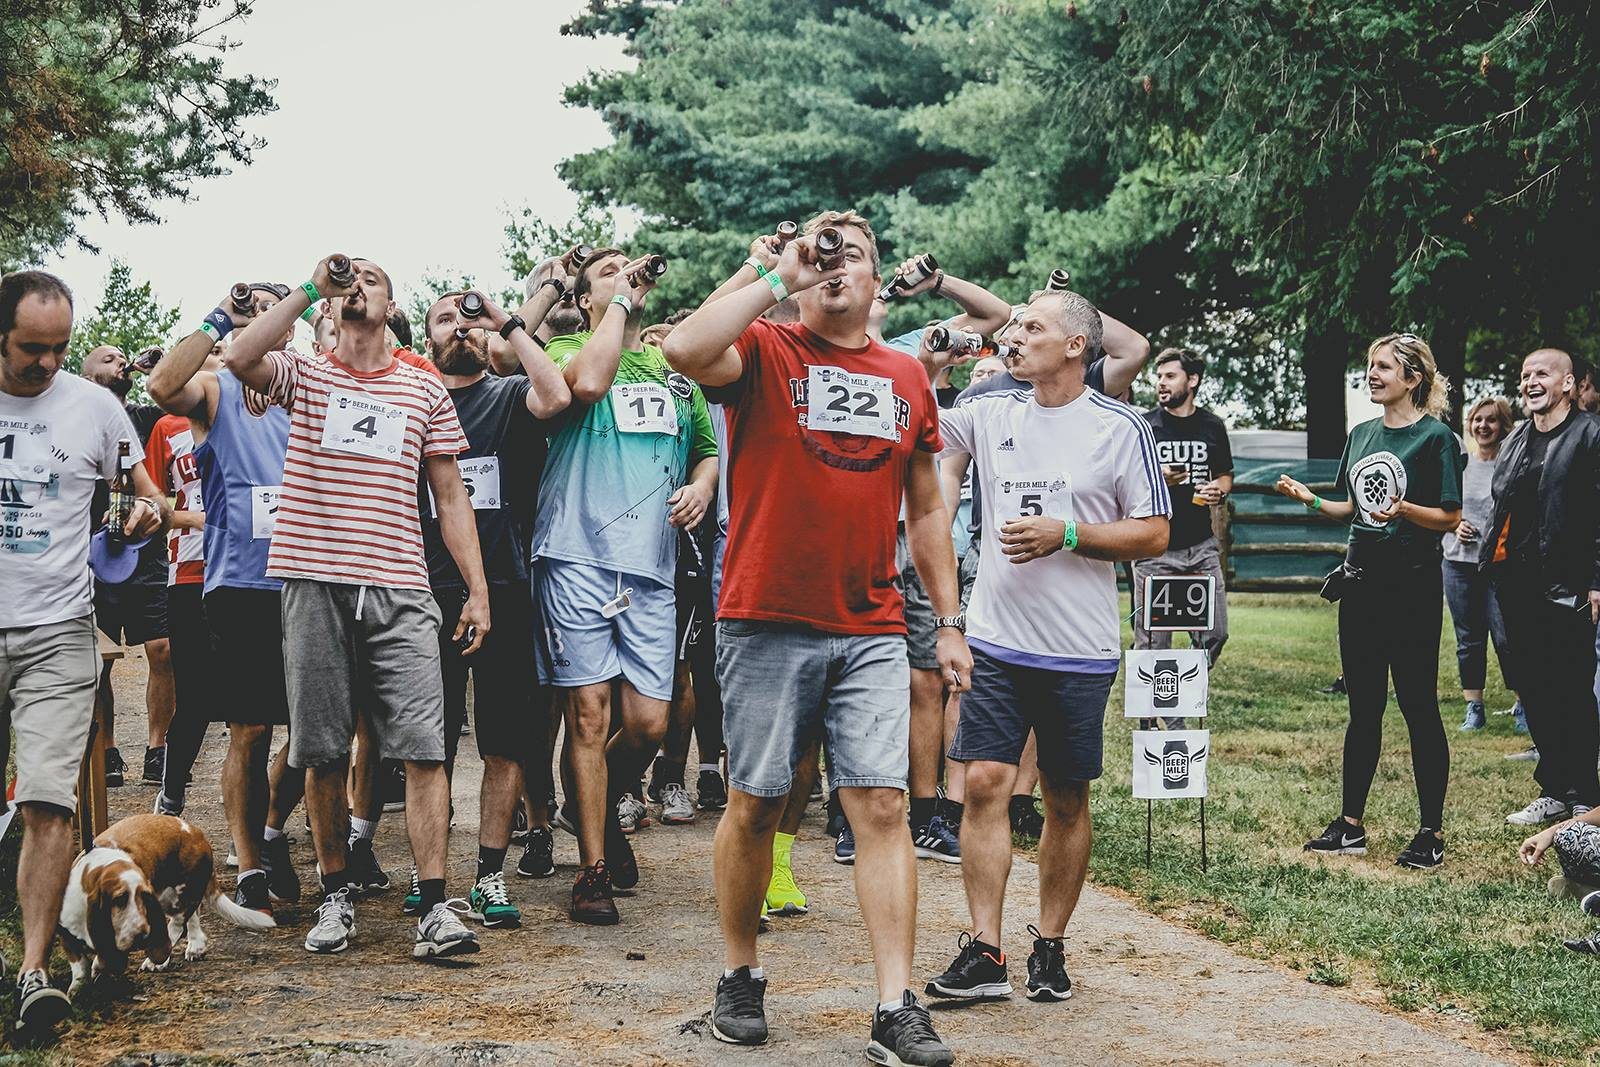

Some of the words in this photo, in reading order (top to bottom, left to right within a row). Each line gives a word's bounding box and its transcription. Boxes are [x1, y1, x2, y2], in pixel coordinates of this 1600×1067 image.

[851, 378, 869, 387] MILE
[826, 385, 880, 417] 22
[352, 400, 369, 410] BEER
[369, 404, 387, 414] MILE
[629, 397, 666, 418] 17
[10, 421, 29, 430] MILE
[352, 415, 377, 439] 4
[1156, 441, 1208, 462] GUB
[1014, 481, 1031, 489] BEER
[1031, 480, 1048, 489] MILE
[1019, 494, 1043, 517] 5
[1151, 582, 1208, 617] 4.9
[1156, 677, 1176, 685] BEER
[1156, 685, 1176, 693] MILE
[1166, 758, 1186, 767] BEER
[1166, 766, 1186, 775] MILE
